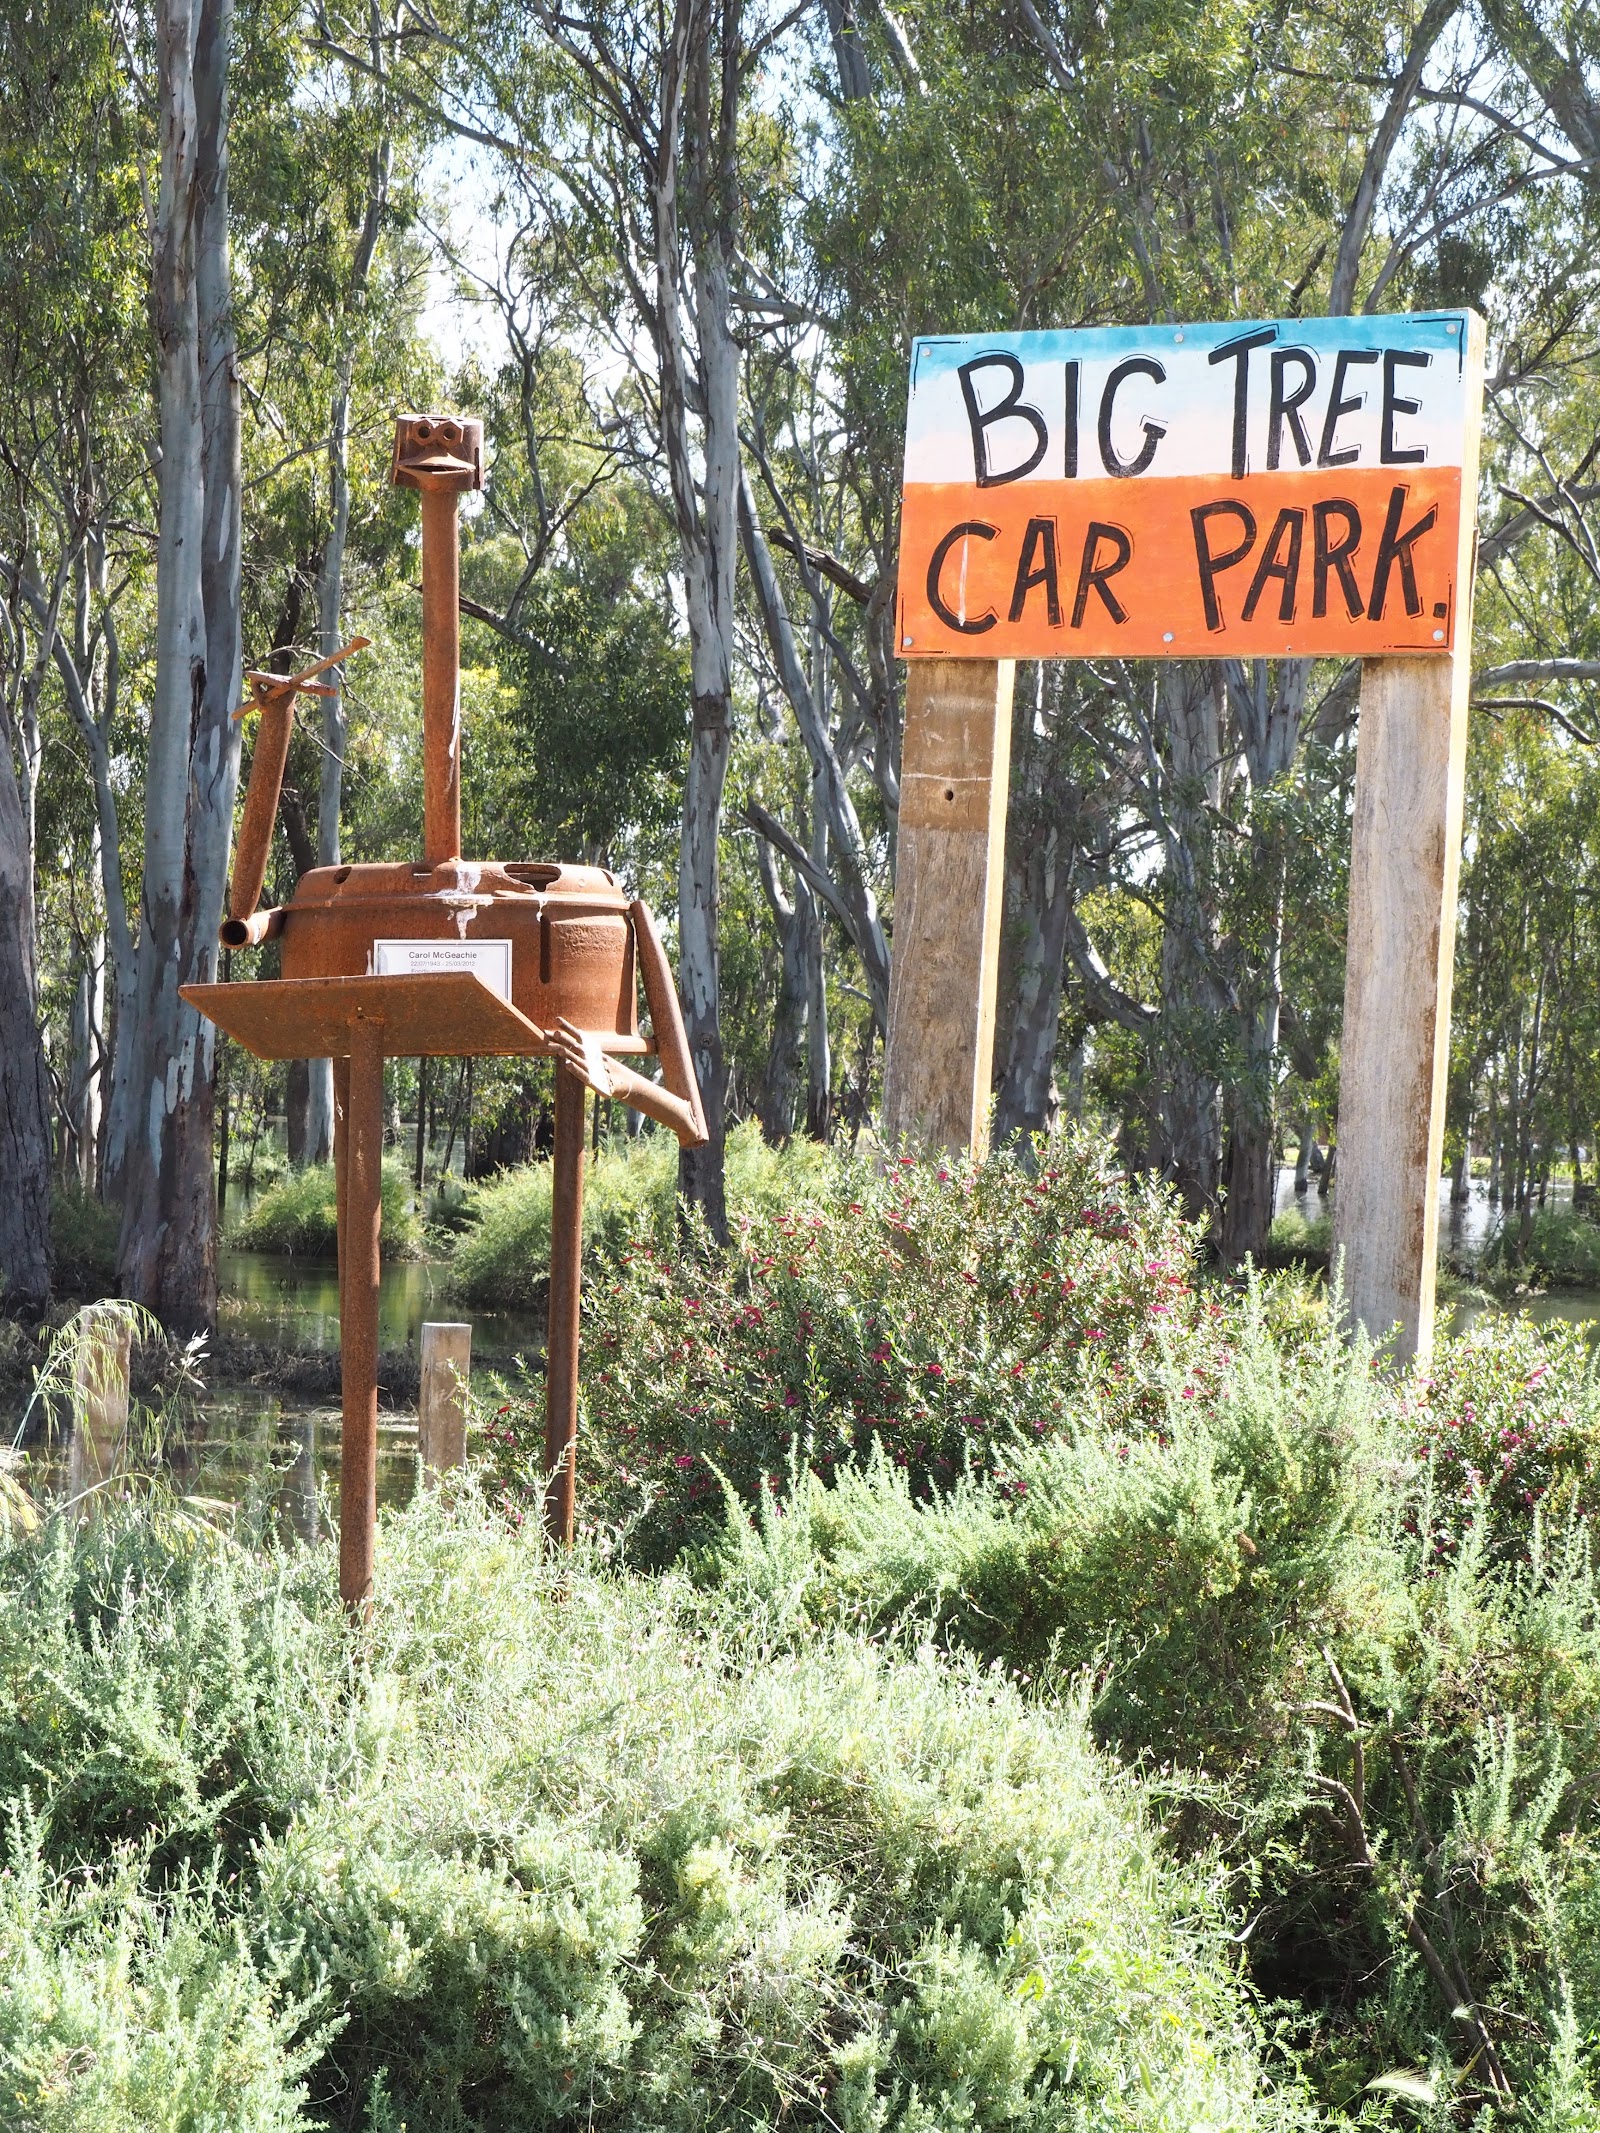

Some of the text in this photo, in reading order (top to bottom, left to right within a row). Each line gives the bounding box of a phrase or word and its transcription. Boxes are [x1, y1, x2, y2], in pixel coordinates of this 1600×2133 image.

[957, 325, 1432, 488] BIG TREE
[926, 484, 1449, 636] CAR PARK.
[408, 951, 477, 959] Carol McGeachie
